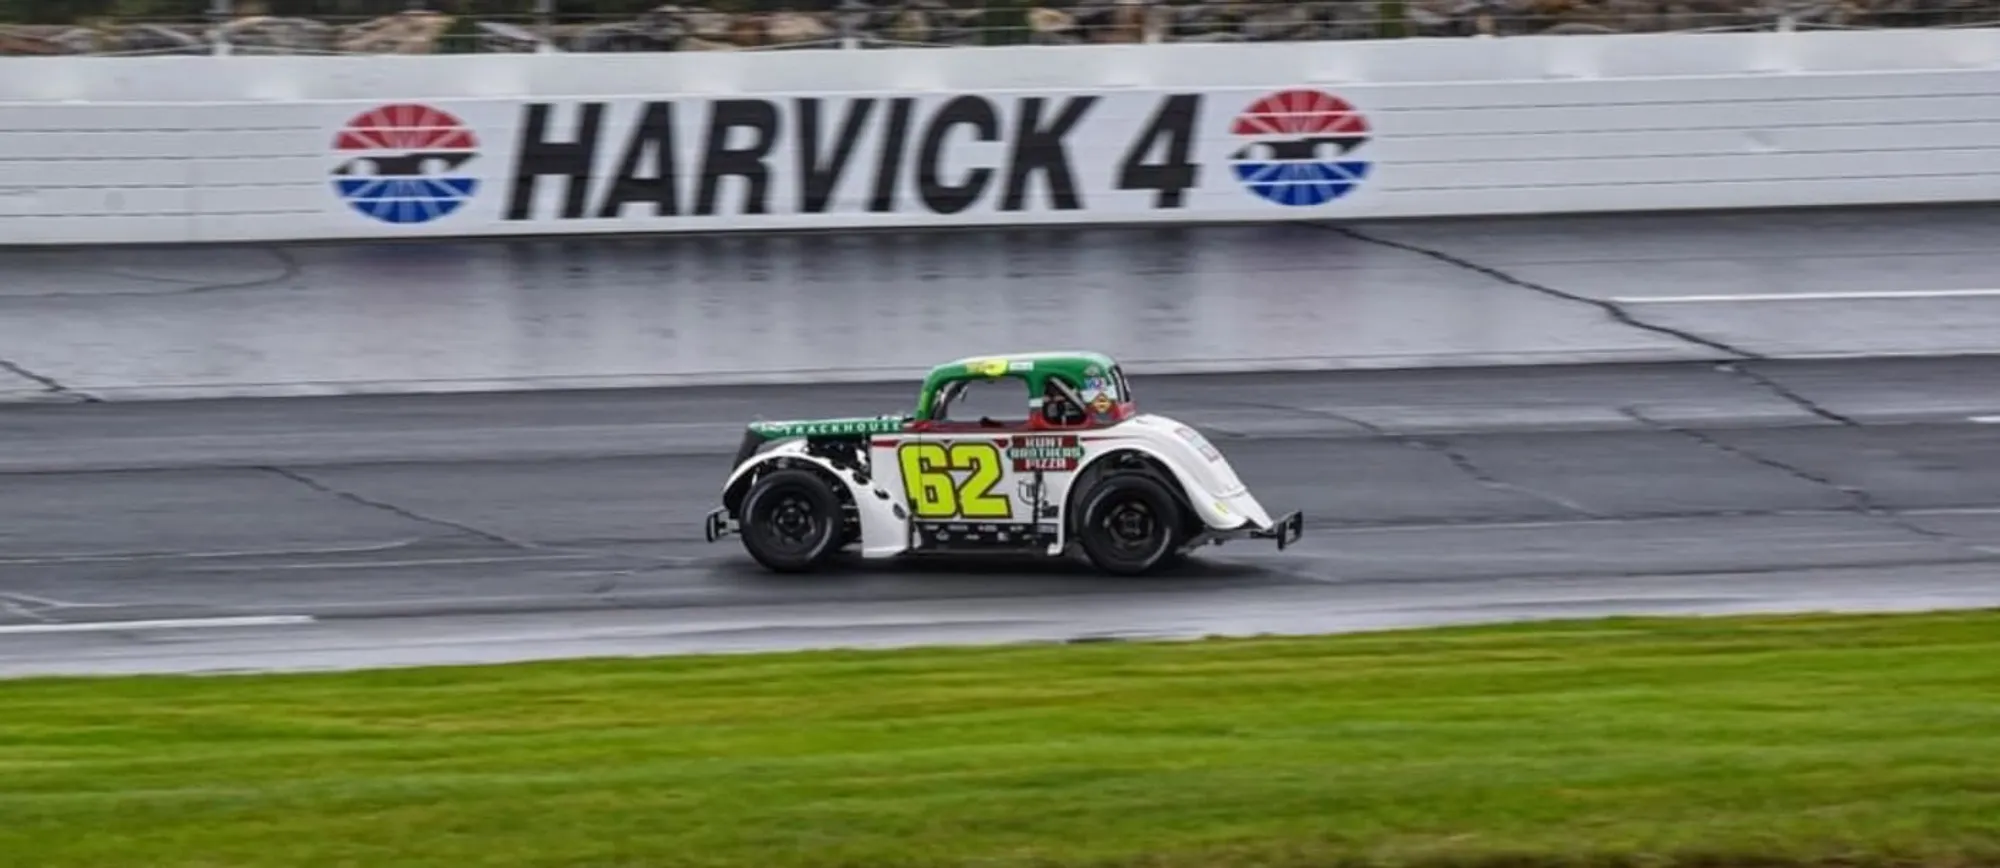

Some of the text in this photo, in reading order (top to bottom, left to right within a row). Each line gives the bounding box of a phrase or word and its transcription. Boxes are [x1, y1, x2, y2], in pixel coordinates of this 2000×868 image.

[504, 93, 1203, 221] HARVICK 4
[784, 422, 899, 435] TRACKHOUSE
[899, 441, 1013, 519] 62
